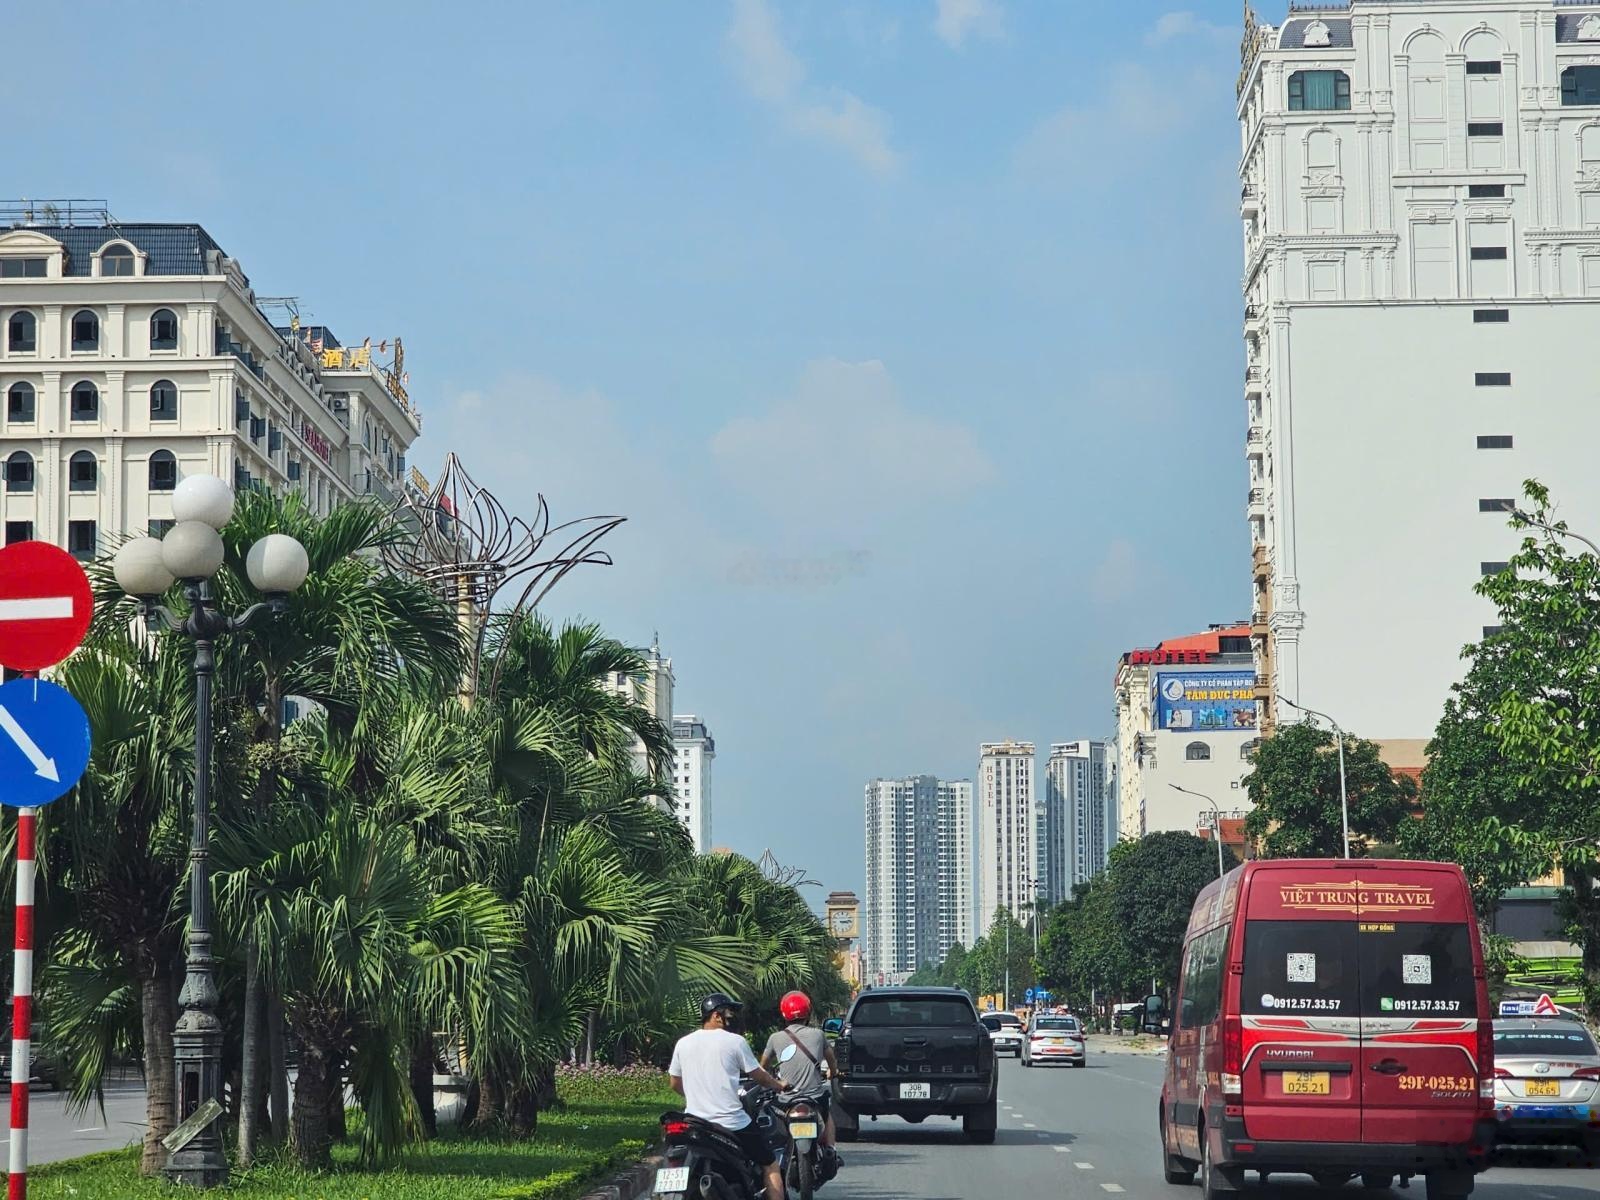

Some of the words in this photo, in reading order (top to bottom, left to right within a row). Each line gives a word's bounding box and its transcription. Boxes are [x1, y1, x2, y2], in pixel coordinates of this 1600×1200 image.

[1130, 649, 1213, 664] HOTEL
[1184, 679, 1200, 687] CÔNG
[1280, 888, 1314, 904] VIỆT
[1317, 891, 1368, 904] TRUNG
[1375, 892, 1435, 905] TRAVEL
[1274, 999, 1340, 1010] 0912.57.33.57
[1394, 1000, 1460, 1010] 0912.57.33.57
[853, 1064, 976, 1072] RANGER
[1288, 1082, 1324, 1092] 025.21
[1398, 1076, 1476, 1090] 29F-025.21
